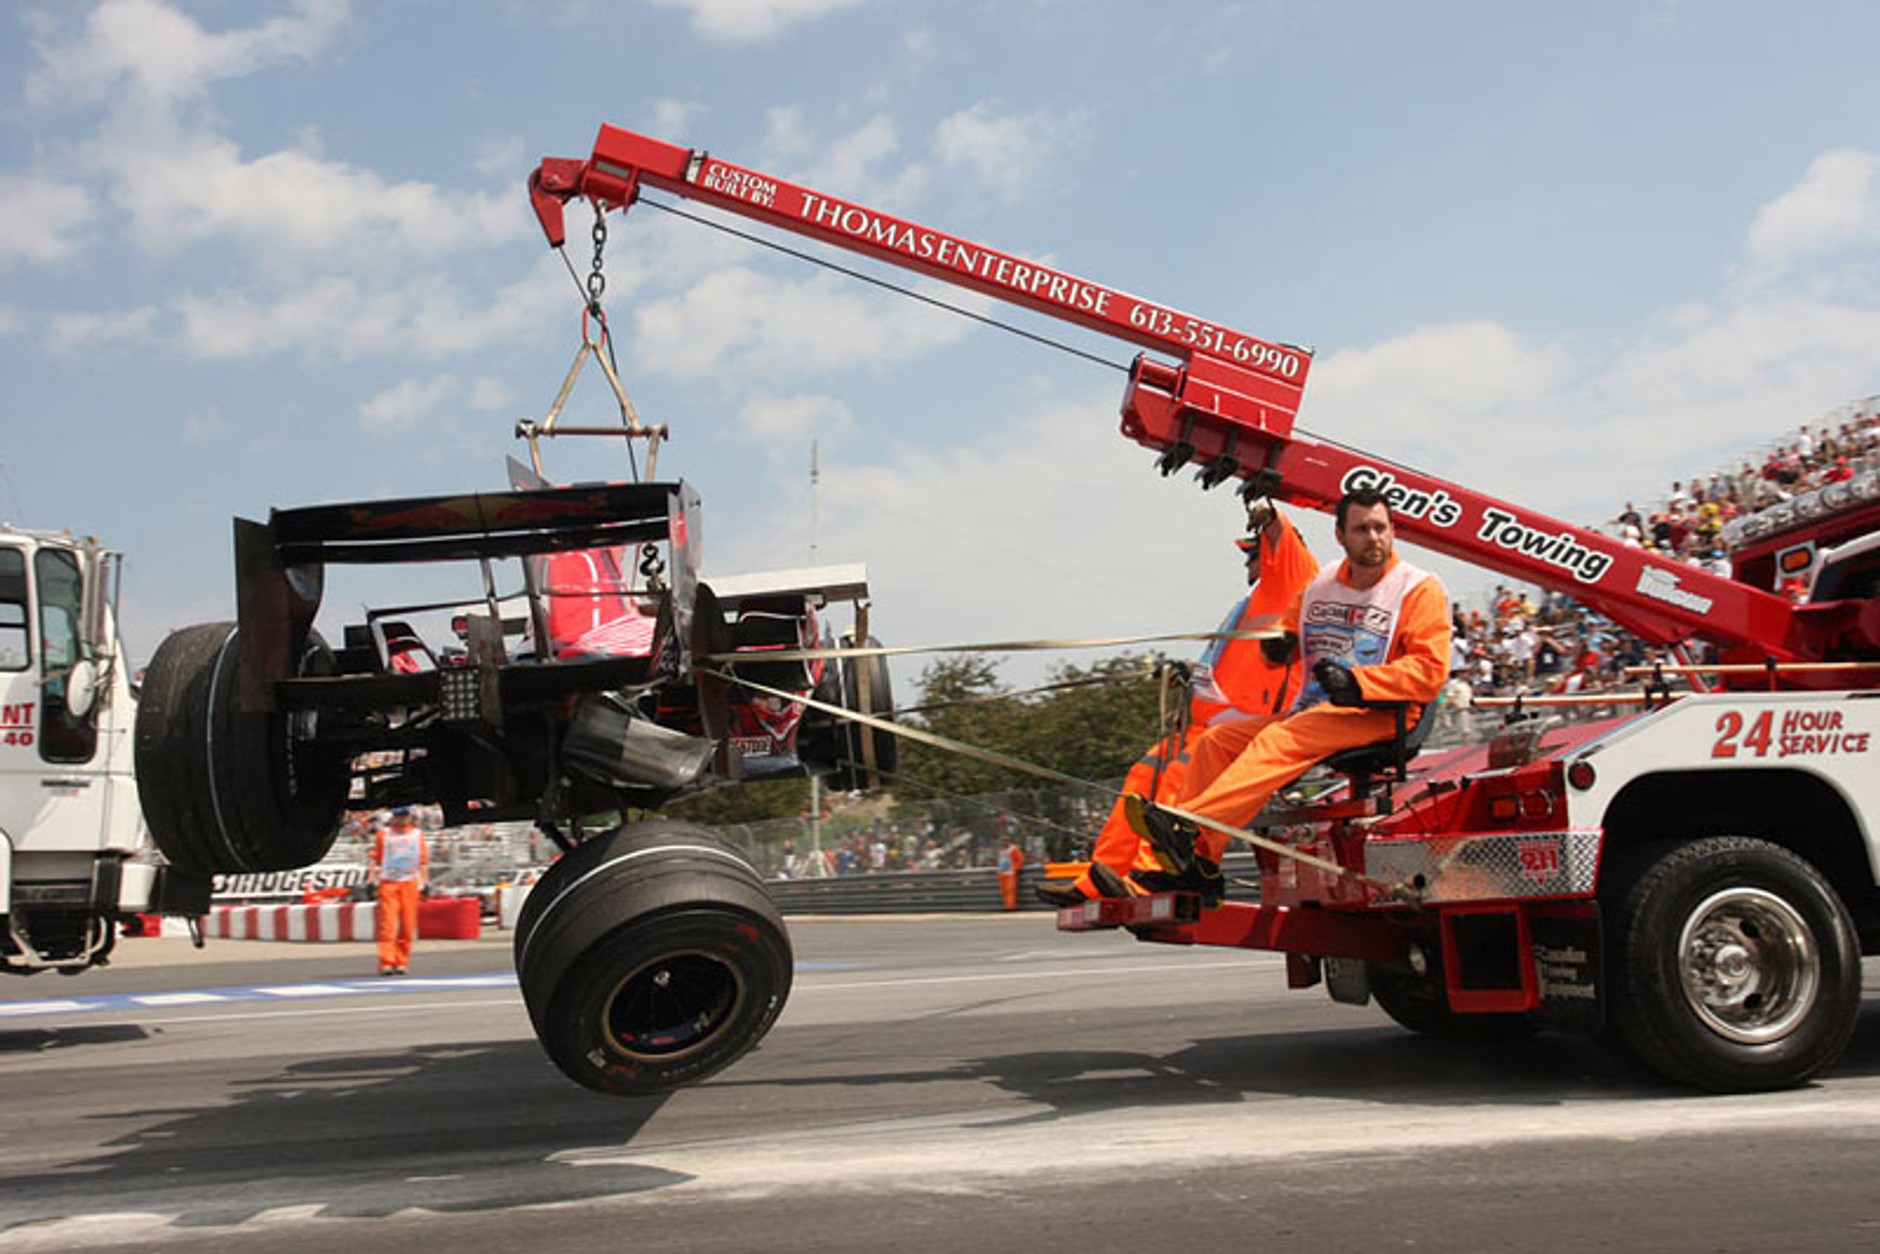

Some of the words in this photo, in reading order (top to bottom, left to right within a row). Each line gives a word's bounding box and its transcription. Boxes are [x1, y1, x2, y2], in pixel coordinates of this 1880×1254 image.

[704, 175, 748, 199] BUILT
[709, 164, 777, 195] CUSTOM
[1130, 303, 1299, 377] 613-551-6990
[1342, 467, 1461, 526] Glen's
[1478, 508, 1611, 581] Towing
[2, 702, 36, 724] NT
[4, 732, 34, 747] 40
[1711, 710, 1774, 759] 24
[1781, 710, 1843, 734] HOUR
[1778, 732, 1870, 758] SERVICE
